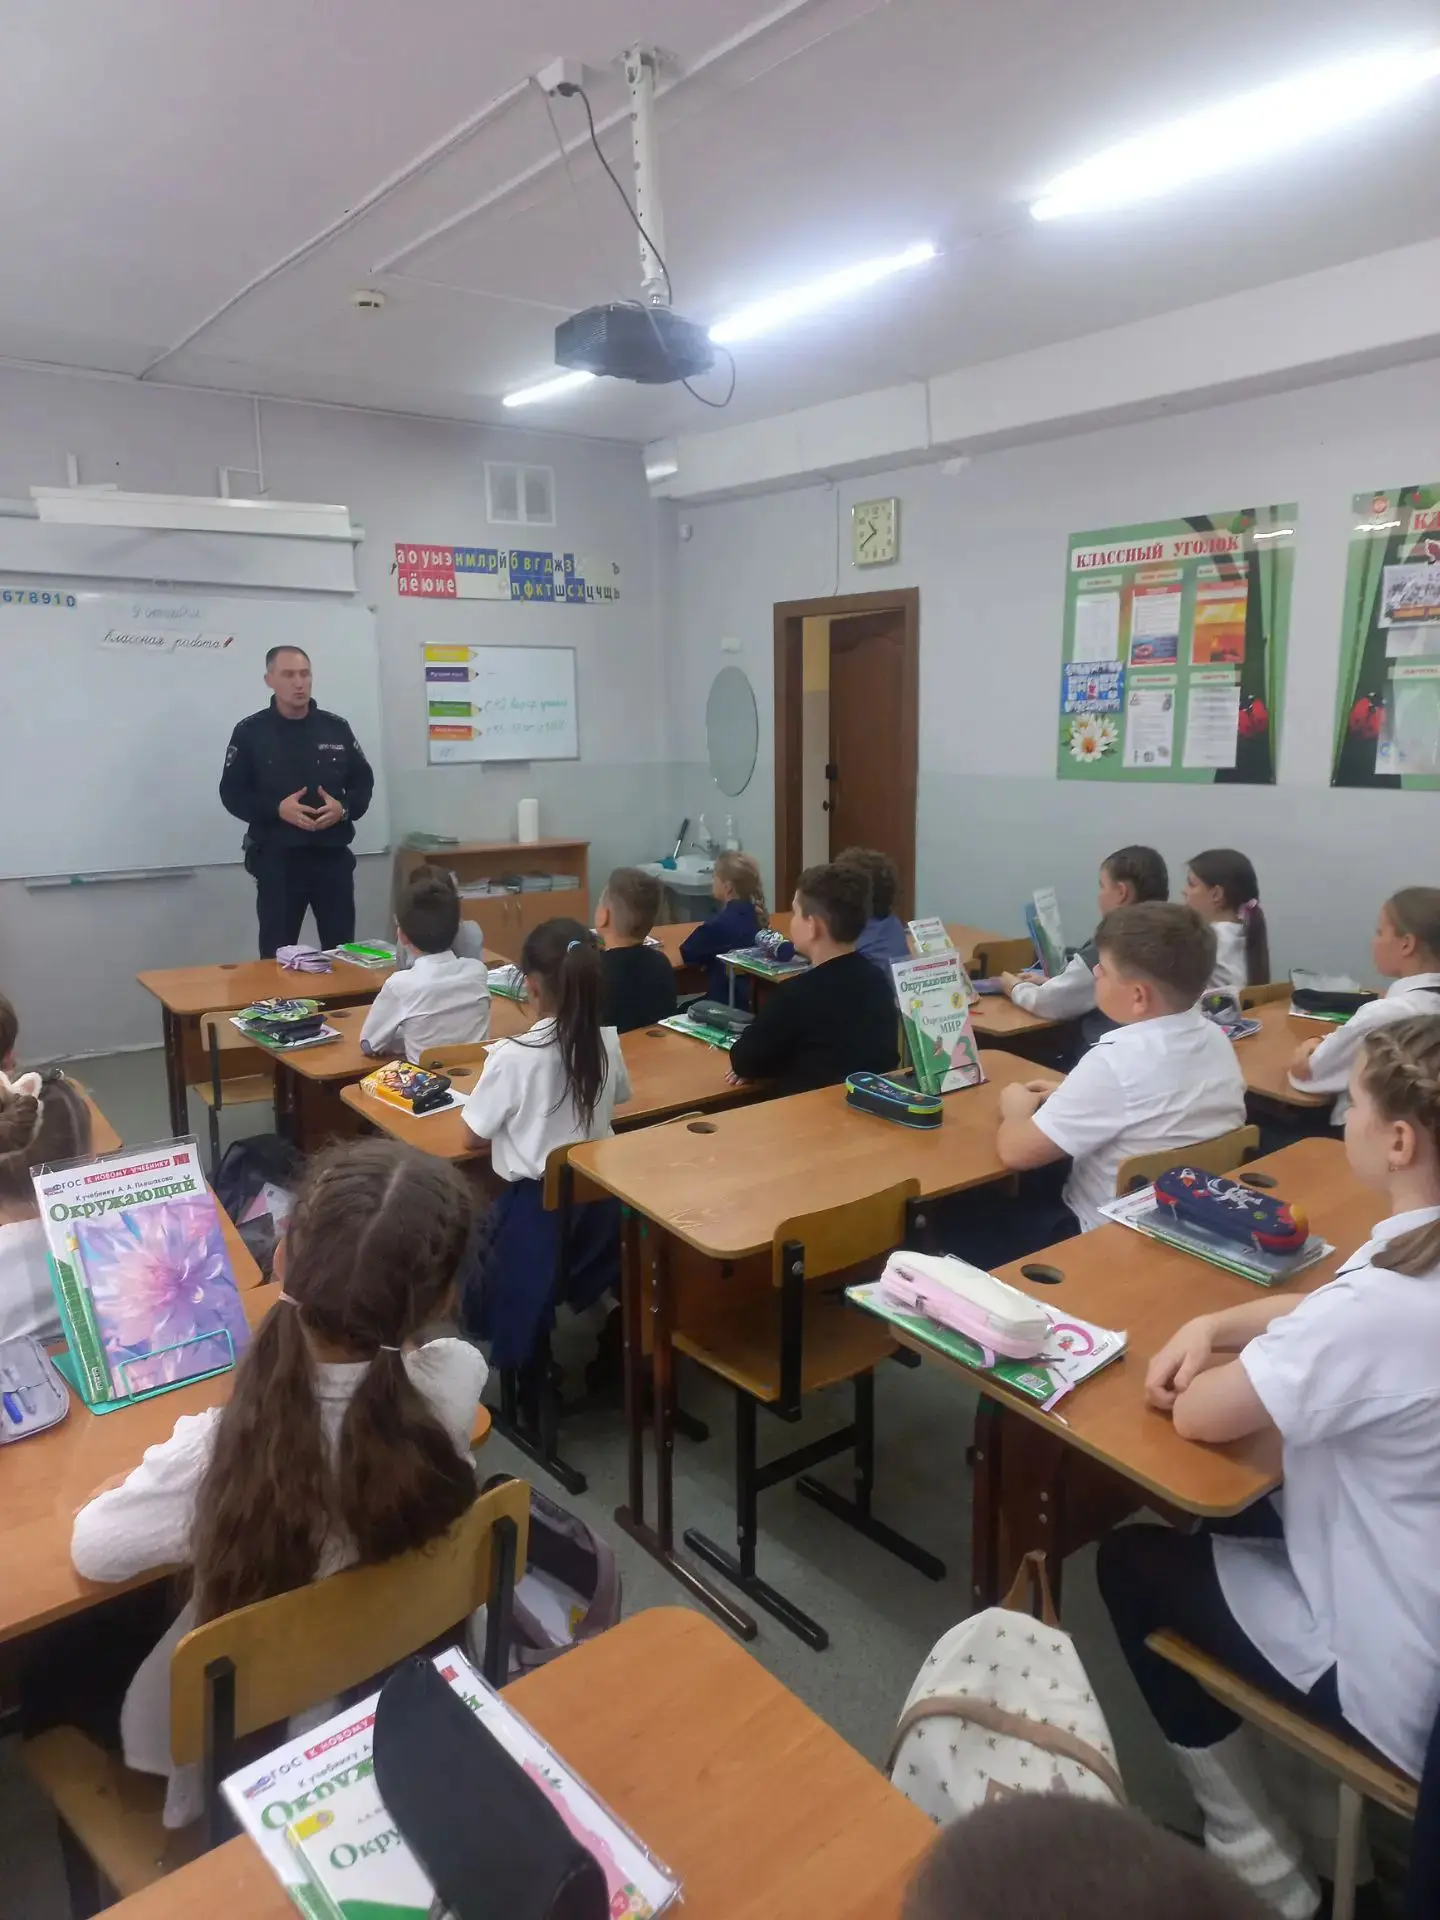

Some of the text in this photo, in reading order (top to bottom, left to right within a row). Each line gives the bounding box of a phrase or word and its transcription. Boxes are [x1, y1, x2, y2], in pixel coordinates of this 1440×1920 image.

[1076, 535, 1239, 569] КЛАССНЫЙ УГОЛОК
[940, 1020, 962, 1034] МИР
[95, 1168, 128, 1183] НОВОМУ
[131, 1159, 170, 1175] УЧЕБНИКУ
[51, 1178, 82, 1191] ФГОС
[82, 1189, 115, 1202] учебнику
[49, 1174, 197, 1222] Окружающий
[322, 1719, 370, 1748] НОВОМУ
[329, 1825, 402, 1870] Окру
